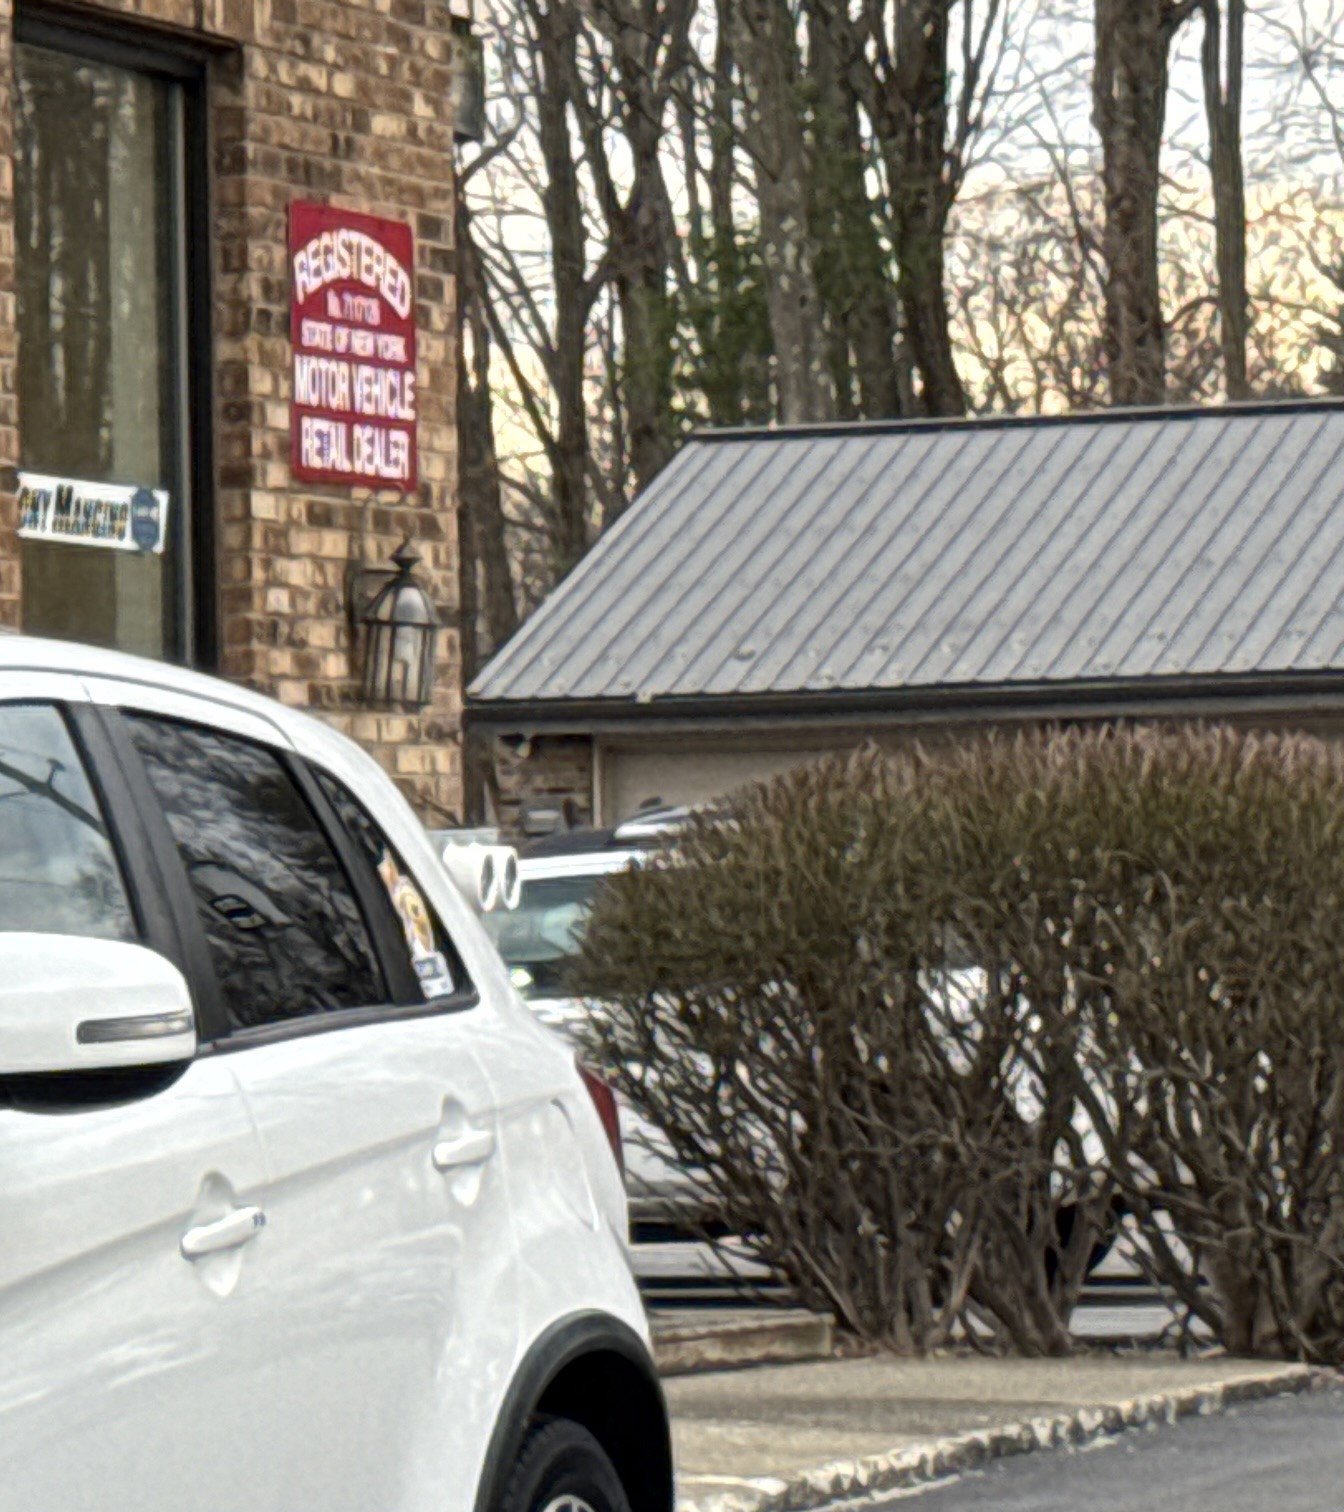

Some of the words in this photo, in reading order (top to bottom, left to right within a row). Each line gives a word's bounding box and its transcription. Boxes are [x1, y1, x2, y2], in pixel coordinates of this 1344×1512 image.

[293, 228, 411, 320] REGISTERED
[294, 354, 351, 411] MOTOR
[352, 362, 415, 421] VEHICLE
[301, 415, 352, 472] RETAIL
[353, 423, 410, 480] DEALER
[18, 486, 54, 533] ONY
